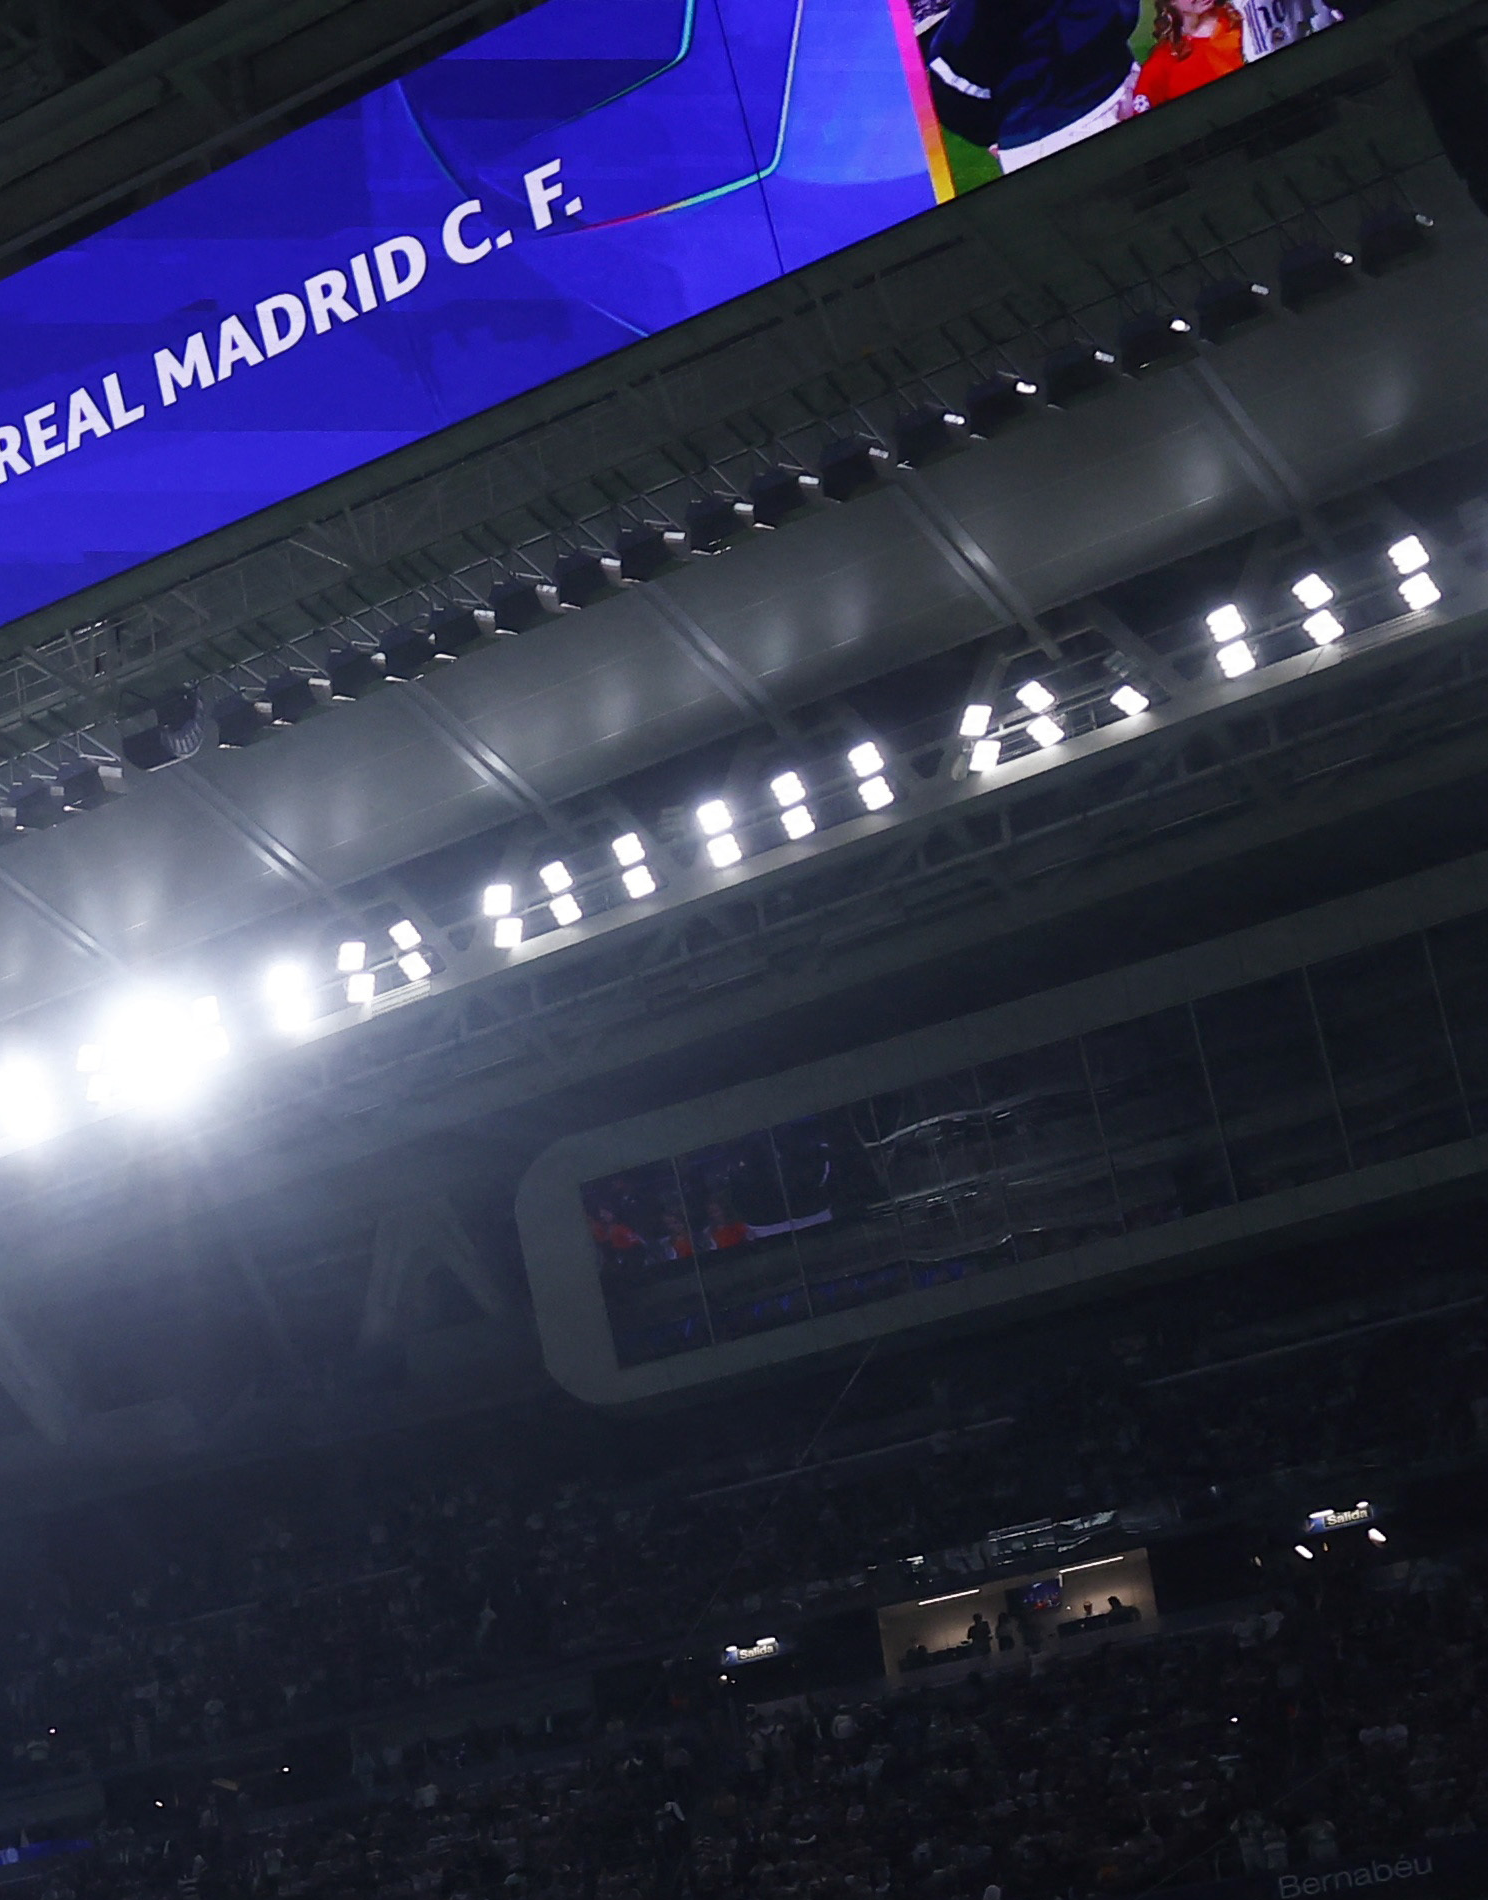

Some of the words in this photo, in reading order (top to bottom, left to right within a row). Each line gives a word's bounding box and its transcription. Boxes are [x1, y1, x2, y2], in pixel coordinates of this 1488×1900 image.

[153, 235, 427, 406] MADRID
[442, 199, 513, 265] C.
[524, 158, 583, 231] F.
[1326, 1509, 1369, 1527] Salida
[1278, 1853, 1434, 1900] Bernabéu
